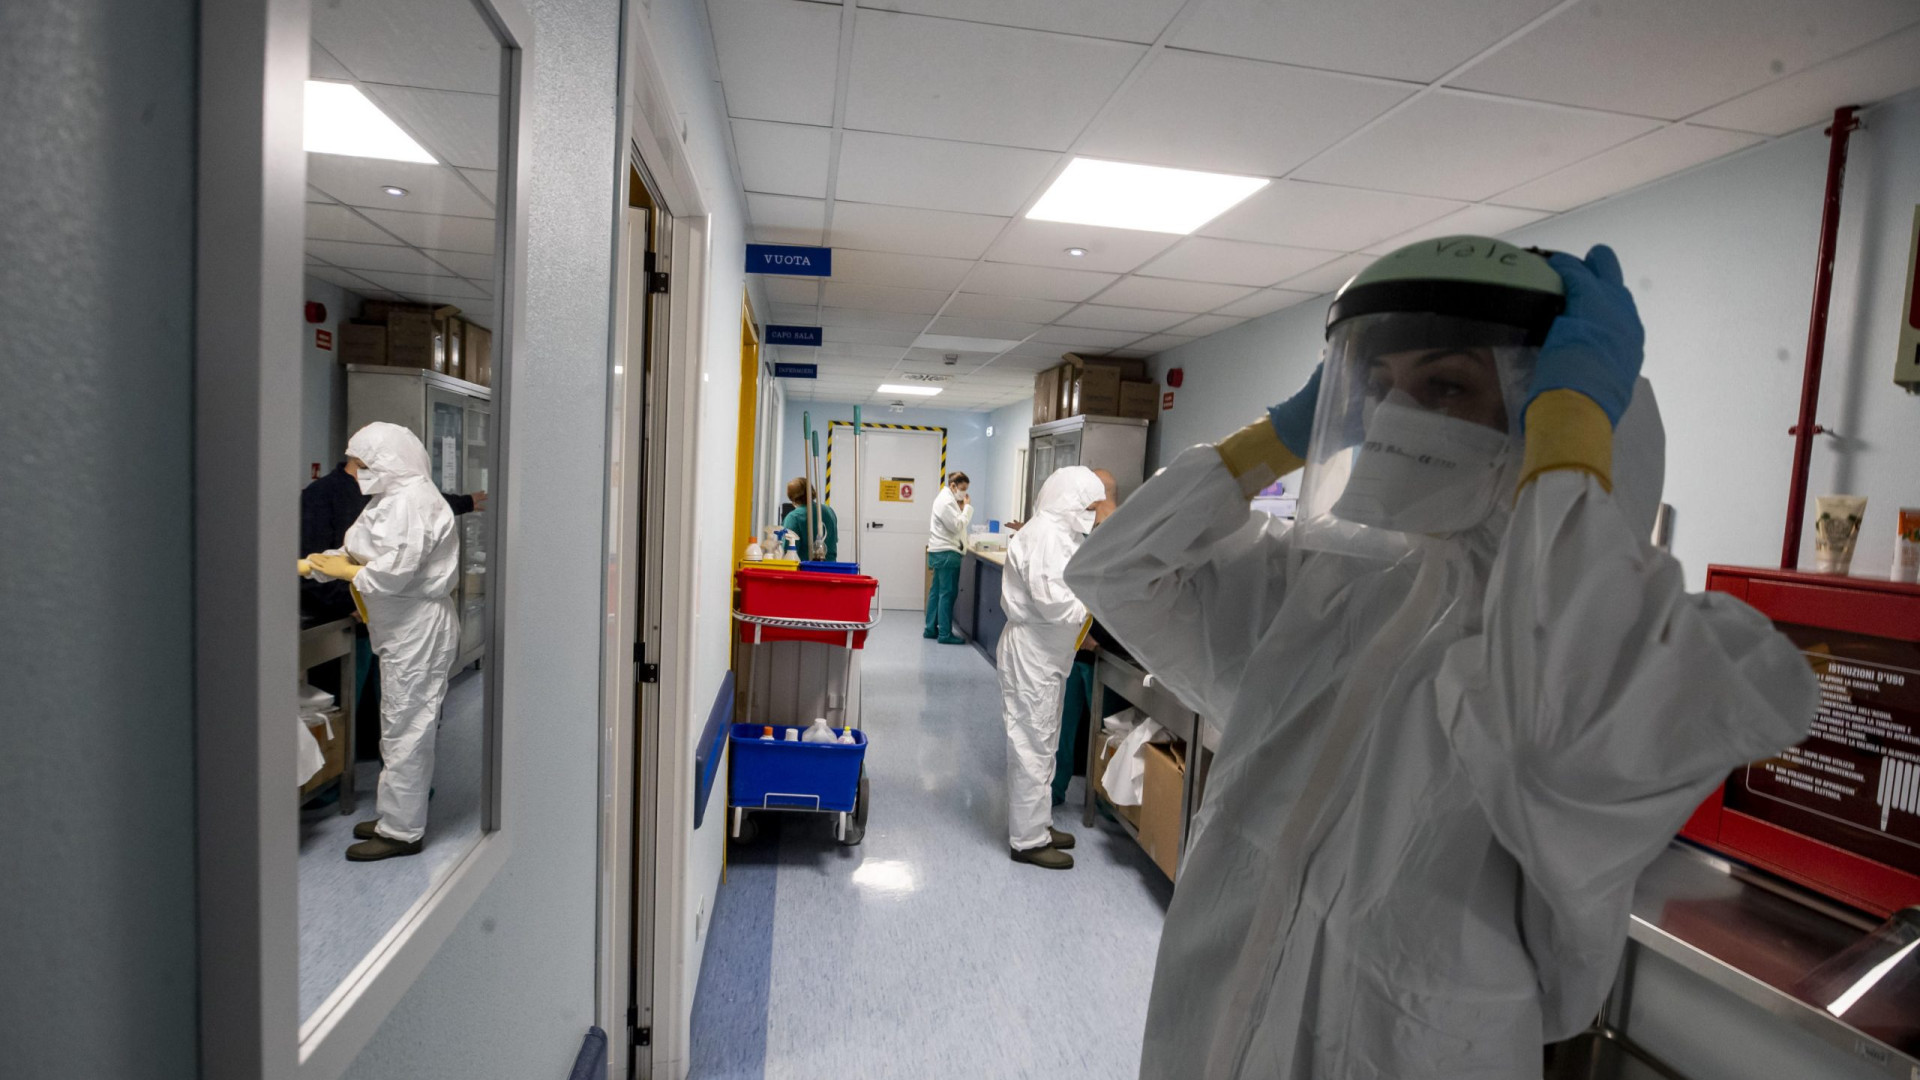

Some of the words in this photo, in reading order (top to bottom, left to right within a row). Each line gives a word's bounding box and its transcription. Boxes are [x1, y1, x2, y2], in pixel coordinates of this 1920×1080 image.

[764, 254, 811, 266] VUOTA
[771, 331, 792, 339] CAPO
[794, 332, 814, 340] SALA
[1828, 662, 1874, 680] ISTRUZIONI
[1877, 672, 1905, 686] D'USO
